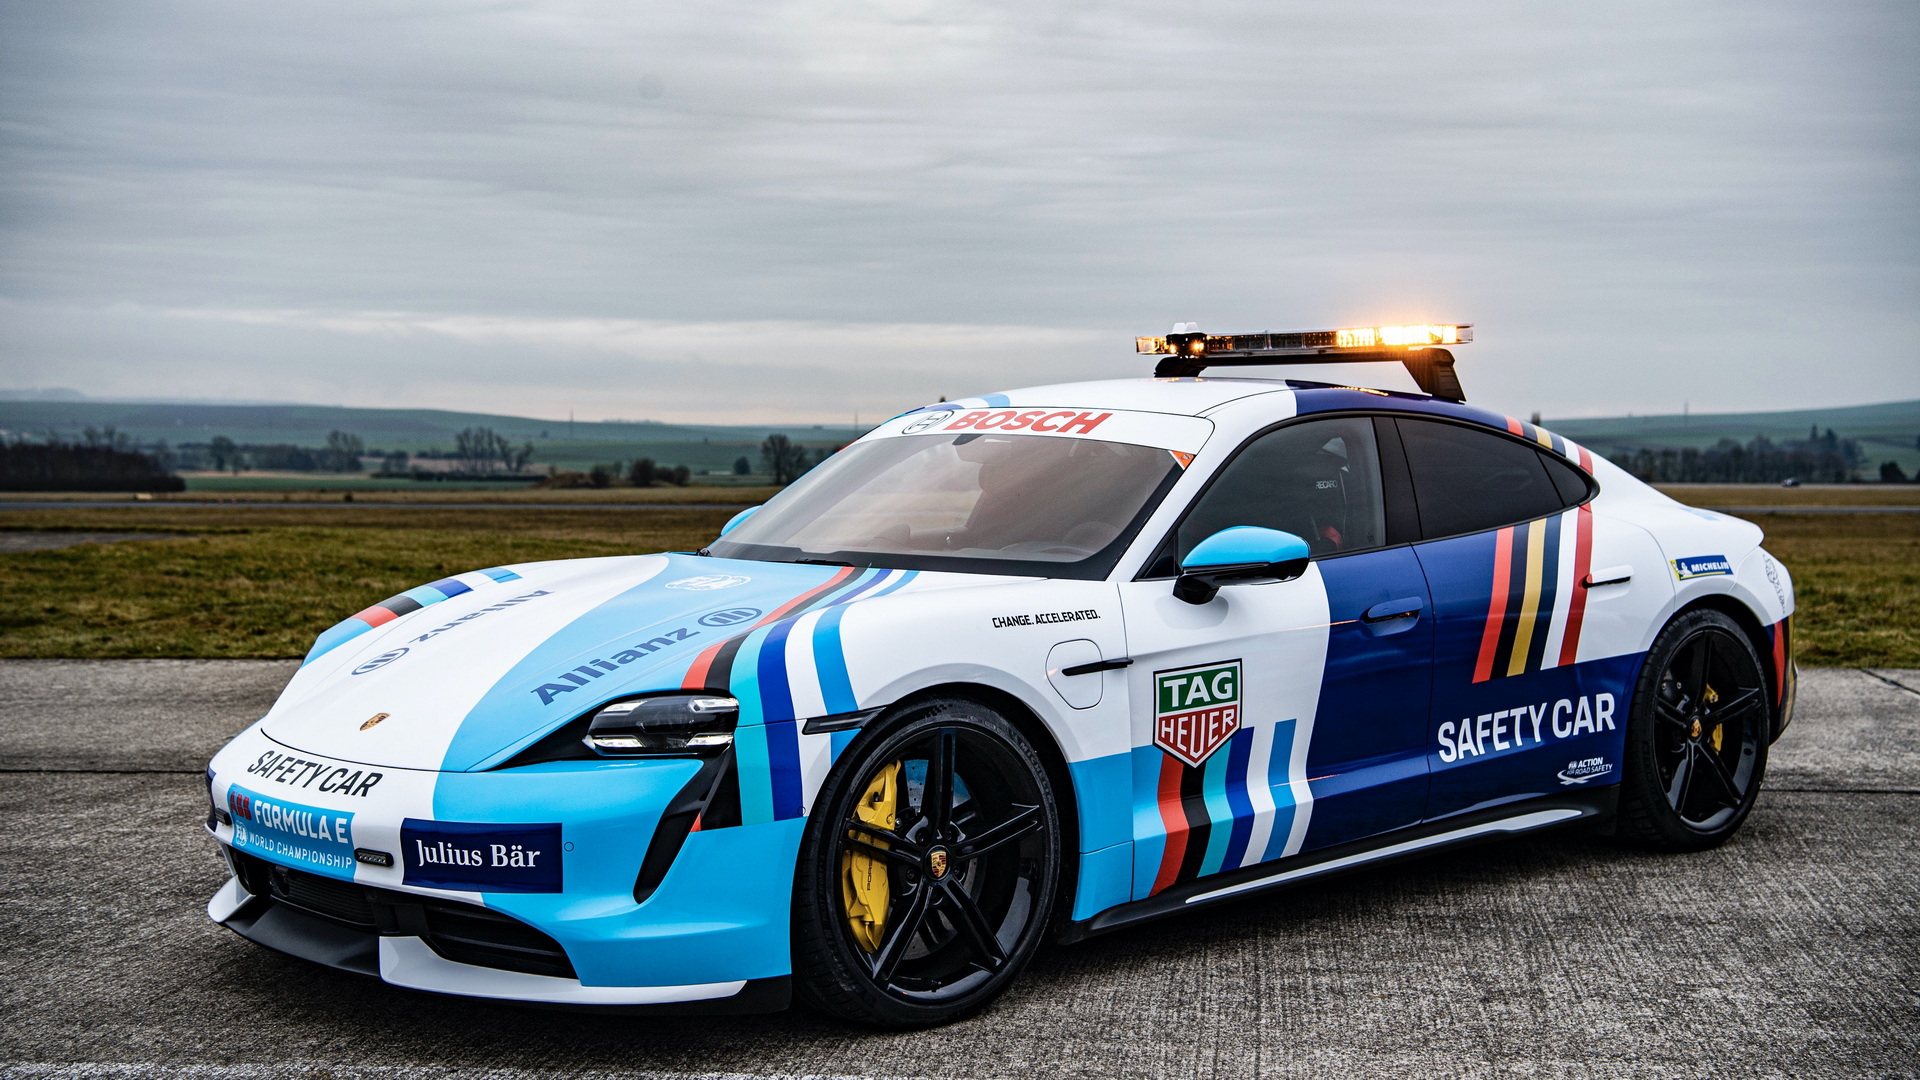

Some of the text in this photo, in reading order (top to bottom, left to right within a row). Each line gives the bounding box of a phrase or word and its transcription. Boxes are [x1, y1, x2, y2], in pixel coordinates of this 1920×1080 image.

[943, 410, 1114, 434] BOSCH
[1315, 480, 1338, 489] RECARO
[1691, 561, 1730, 573] MICHELIN
[408, 589, 555, 644] Allianz
[991, 608, 1101, 628] CHANGE. ACCELERATED.
[530, 627, 701, 706] Allianz
[1163, 670, 1233, 708] TAG
[1160, 708, 1235, 759] HEUER
[1437, 692, 1616, 763] SAFETY CAR
[247, 750, 384, 797] SAFETY CAR
[1575, 767, 1590, 775] ROAD
[1591, 763, 1613, 773] SAFETY
[1577, 757, 1603, 768] ACTION
[229, 791, 349, 844] ABB FORMULA E
[248, 832, 353, 869] WORLD CHAMPIONSHIP
[415, 839, 540, 868] Julius Bär
